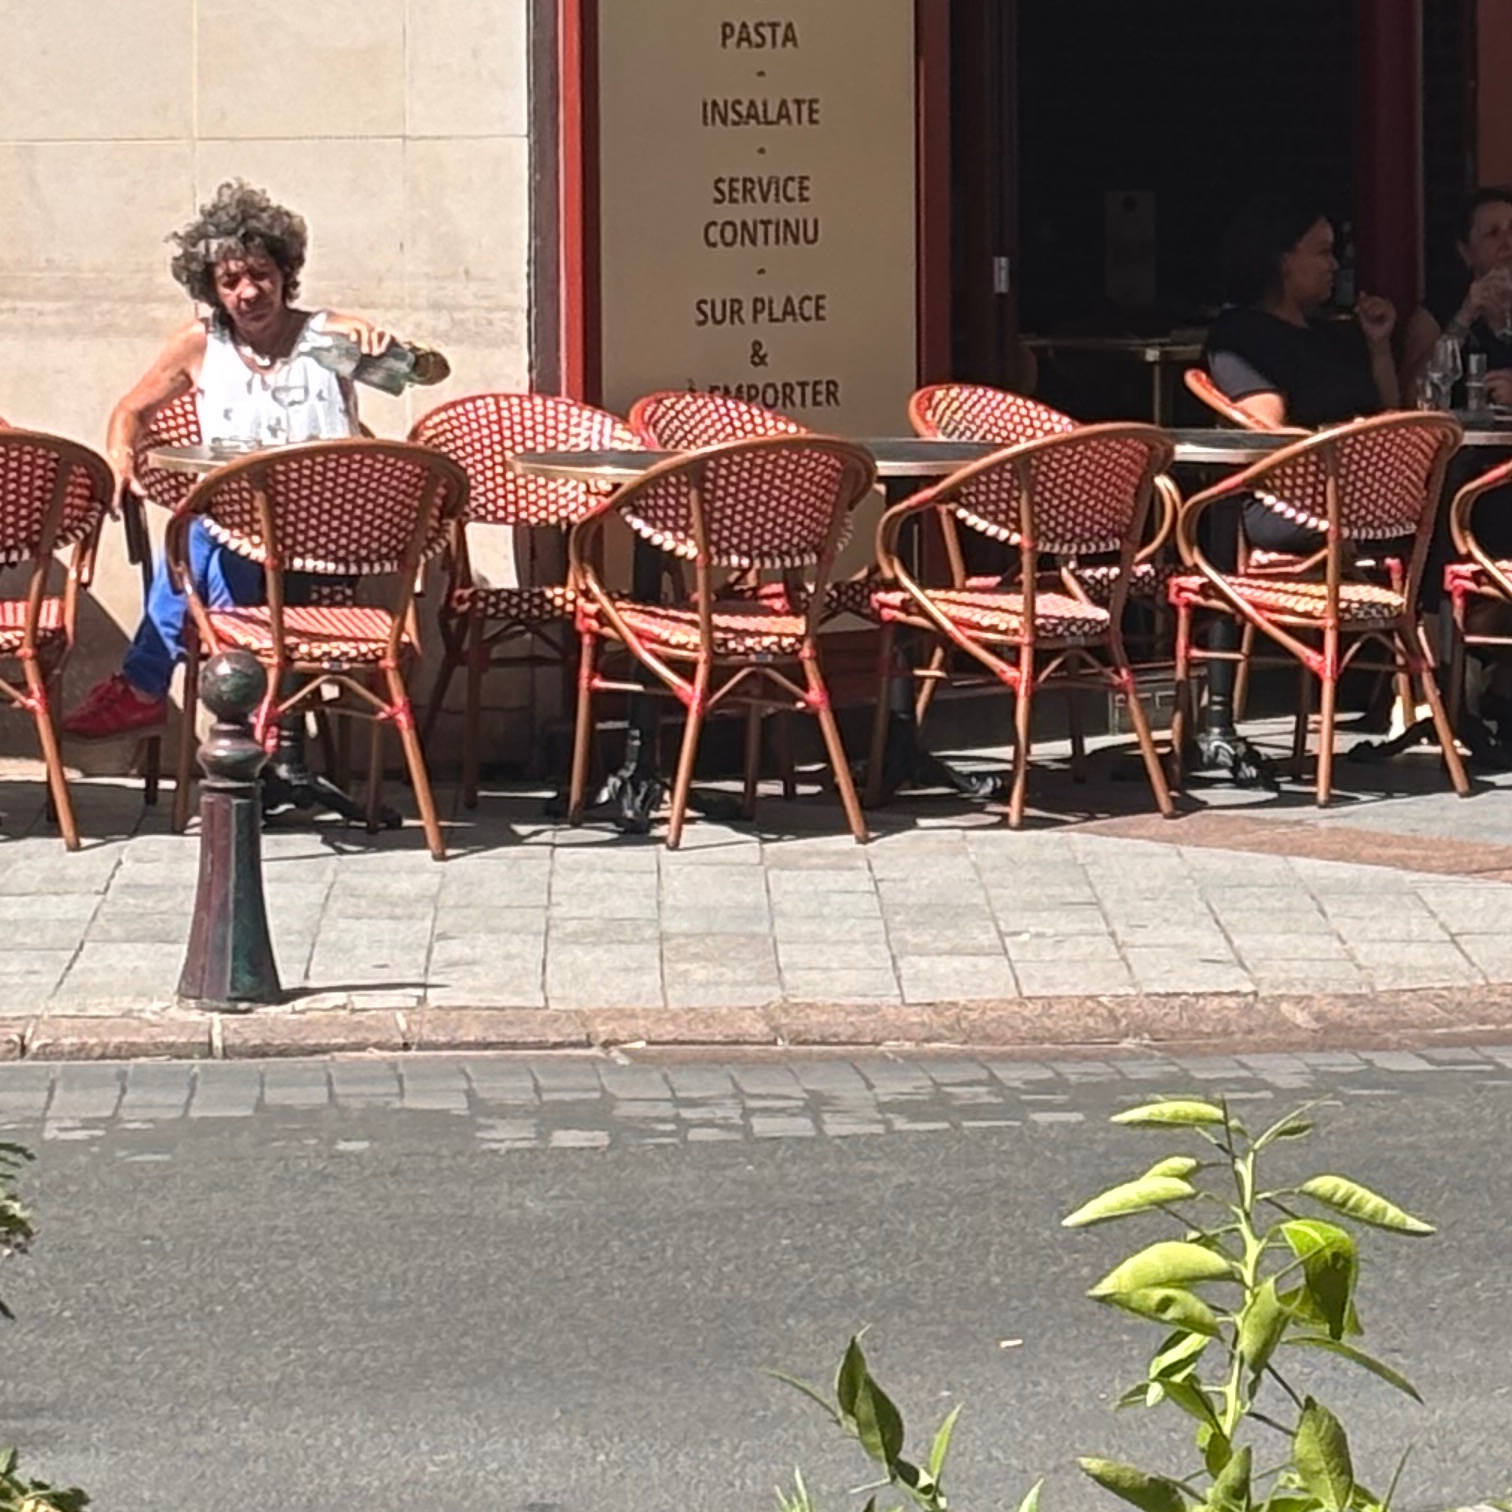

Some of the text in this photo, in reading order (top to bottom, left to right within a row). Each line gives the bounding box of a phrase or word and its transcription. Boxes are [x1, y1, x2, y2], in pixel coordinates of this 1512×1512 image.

[721, 21, 799, 49] PASTA
[702, 98, 821, 127] INSALATE
[713, 175, 811, 205] SERVICE
[703, 218, 820, 248] CONTINU
[695, 295, 827, 327] SUR PLACE
[750, 339, 769, 368] &
